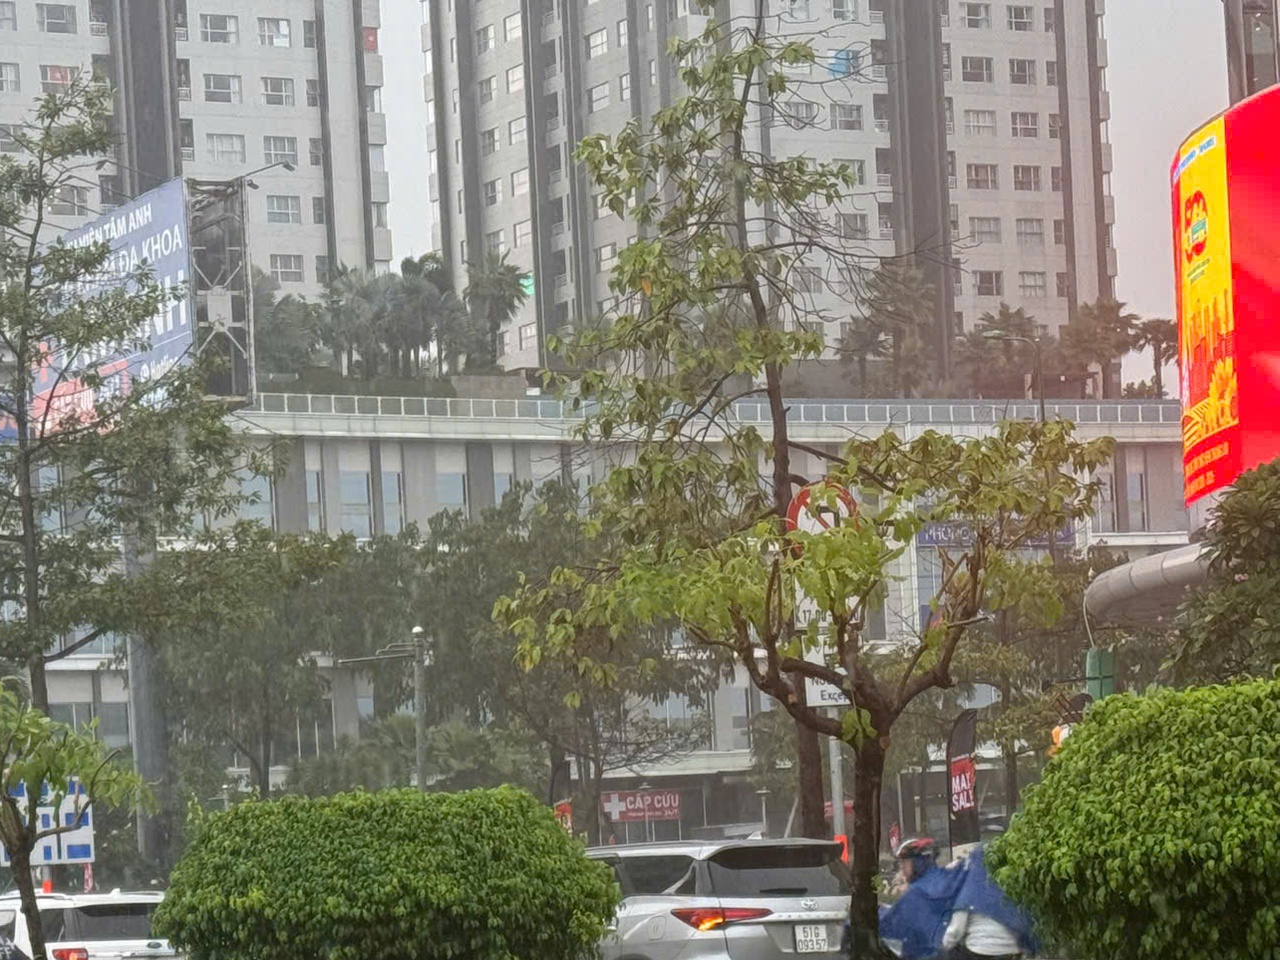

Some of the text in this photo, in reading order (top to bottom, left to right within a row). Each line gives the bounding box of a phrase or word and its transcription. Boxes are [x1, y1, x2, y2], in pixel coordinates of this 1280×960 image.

[103, 216, 127, 240] TÂM
[128, 202, 152, 233] ANH
[141, 225, 183, 265] KHOA
[626, 792, 679, 810] CẤP CỨU
[802, 926, 820, 938] 51G
